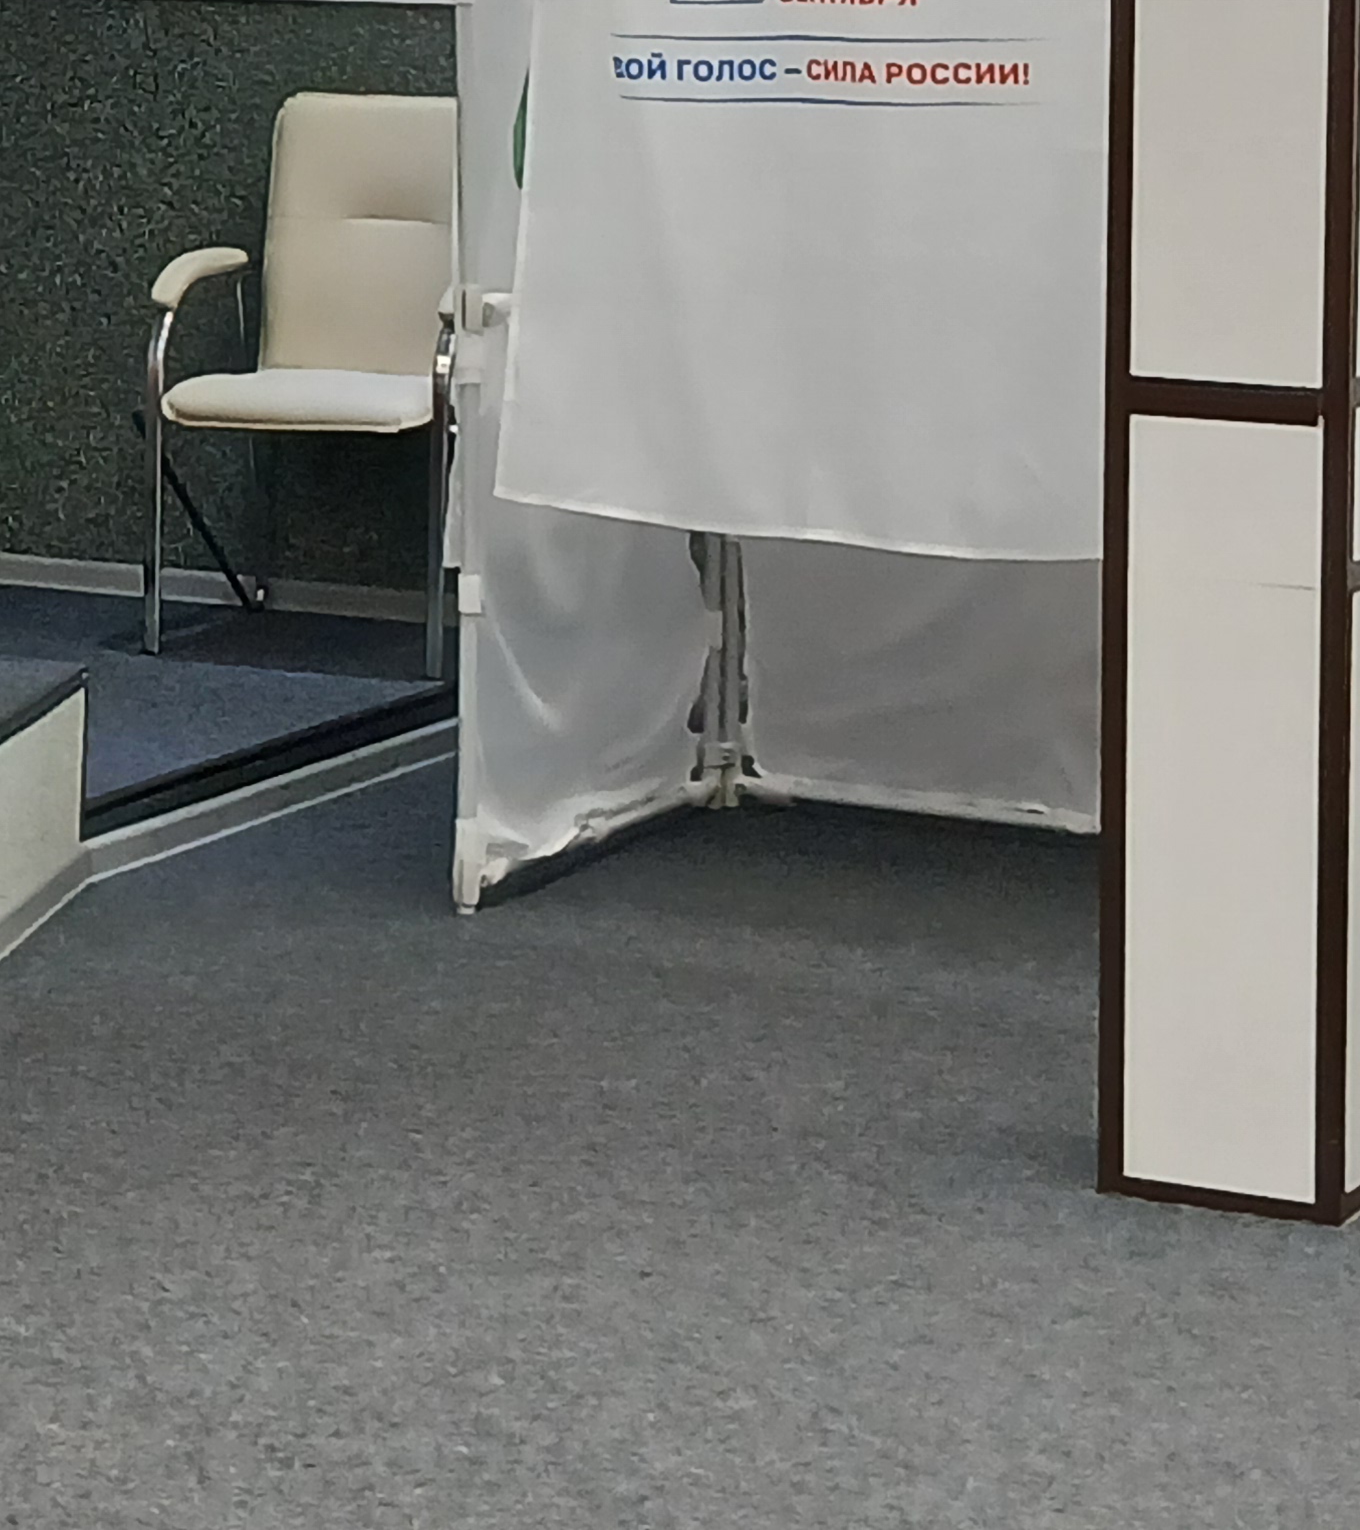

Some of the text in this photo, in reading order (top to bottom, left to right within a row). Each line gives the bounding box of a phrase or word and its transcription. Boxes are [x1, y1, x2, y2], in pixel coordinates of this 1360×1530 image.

[677, 59, 777, 82] ГОЛОС
[806, 59, 877, 84] СИЛА
[885, 63, 1030, 86] РОССИИ!
